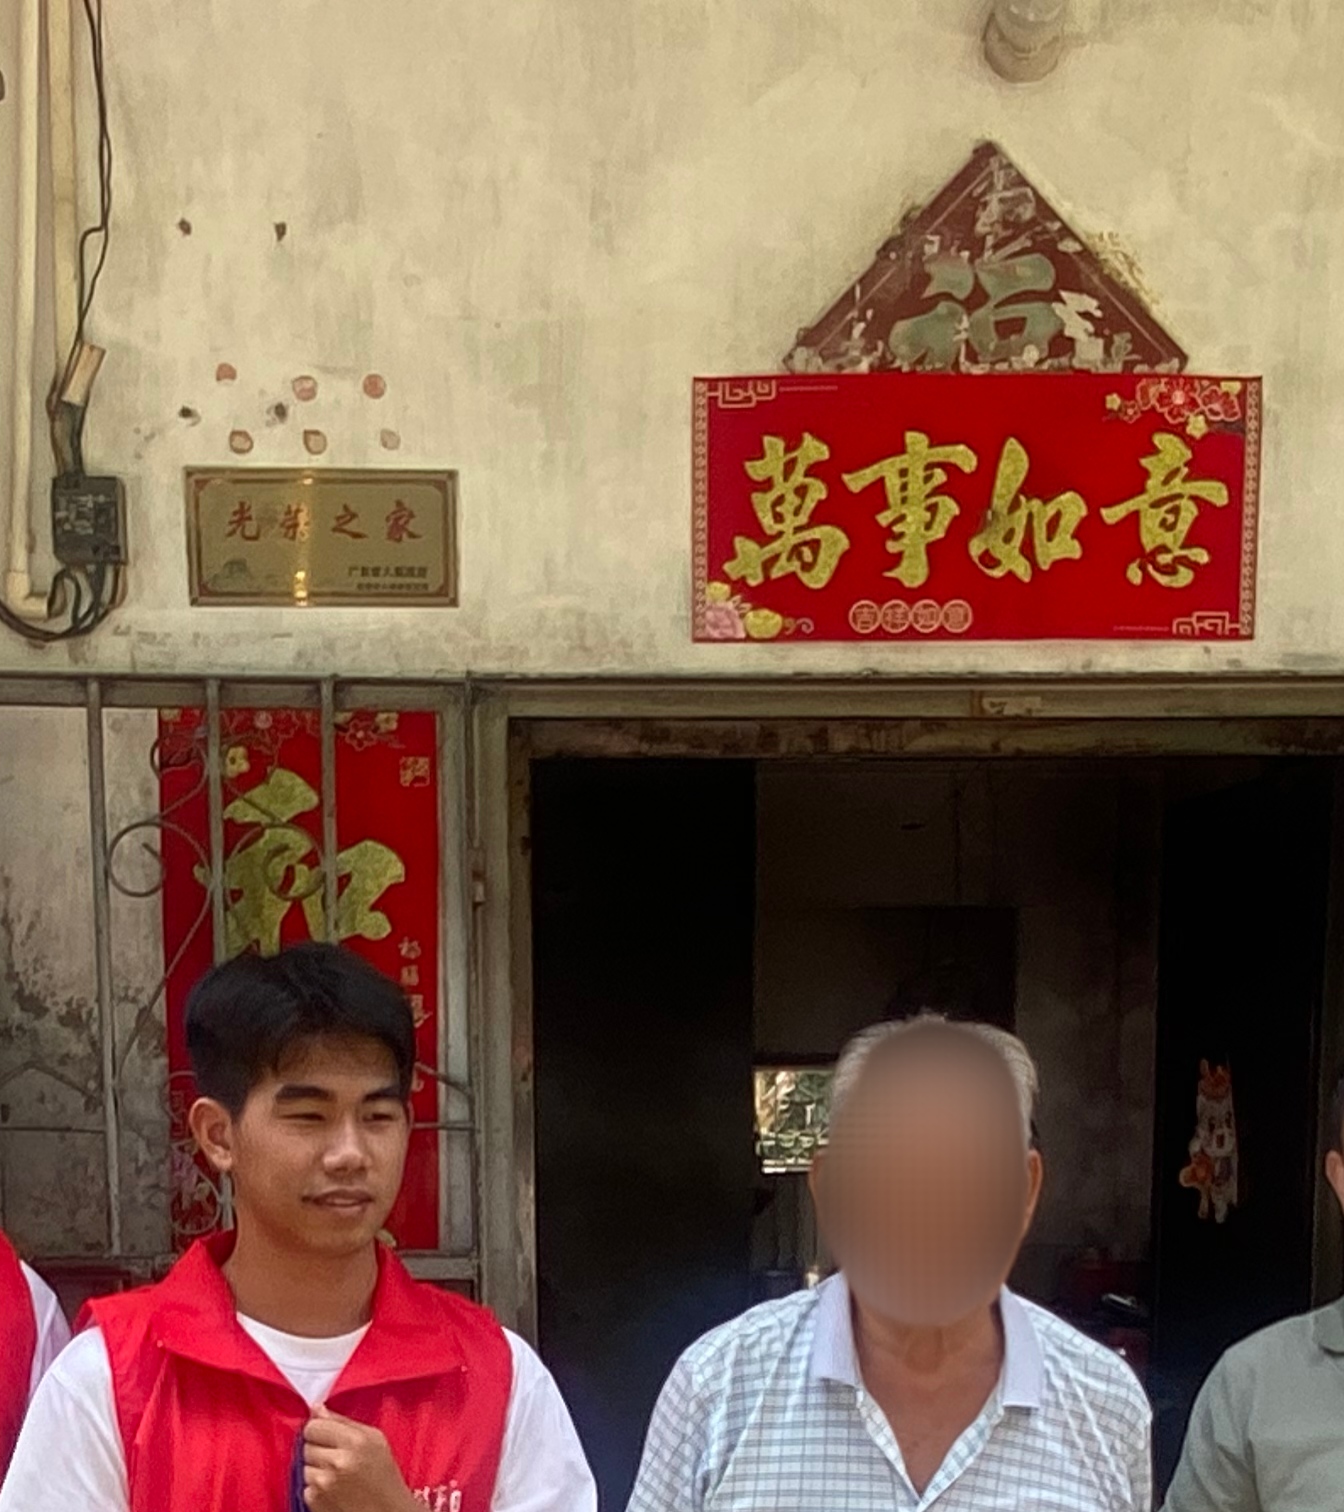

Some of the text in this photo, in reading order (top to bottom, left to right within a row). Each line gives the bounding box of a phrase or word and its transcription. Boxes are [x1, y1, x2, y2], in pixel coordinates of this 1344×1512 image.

[225, 499, 423, 543] 光荣之家
[723, 431, 1229, 589] 萬事如意
